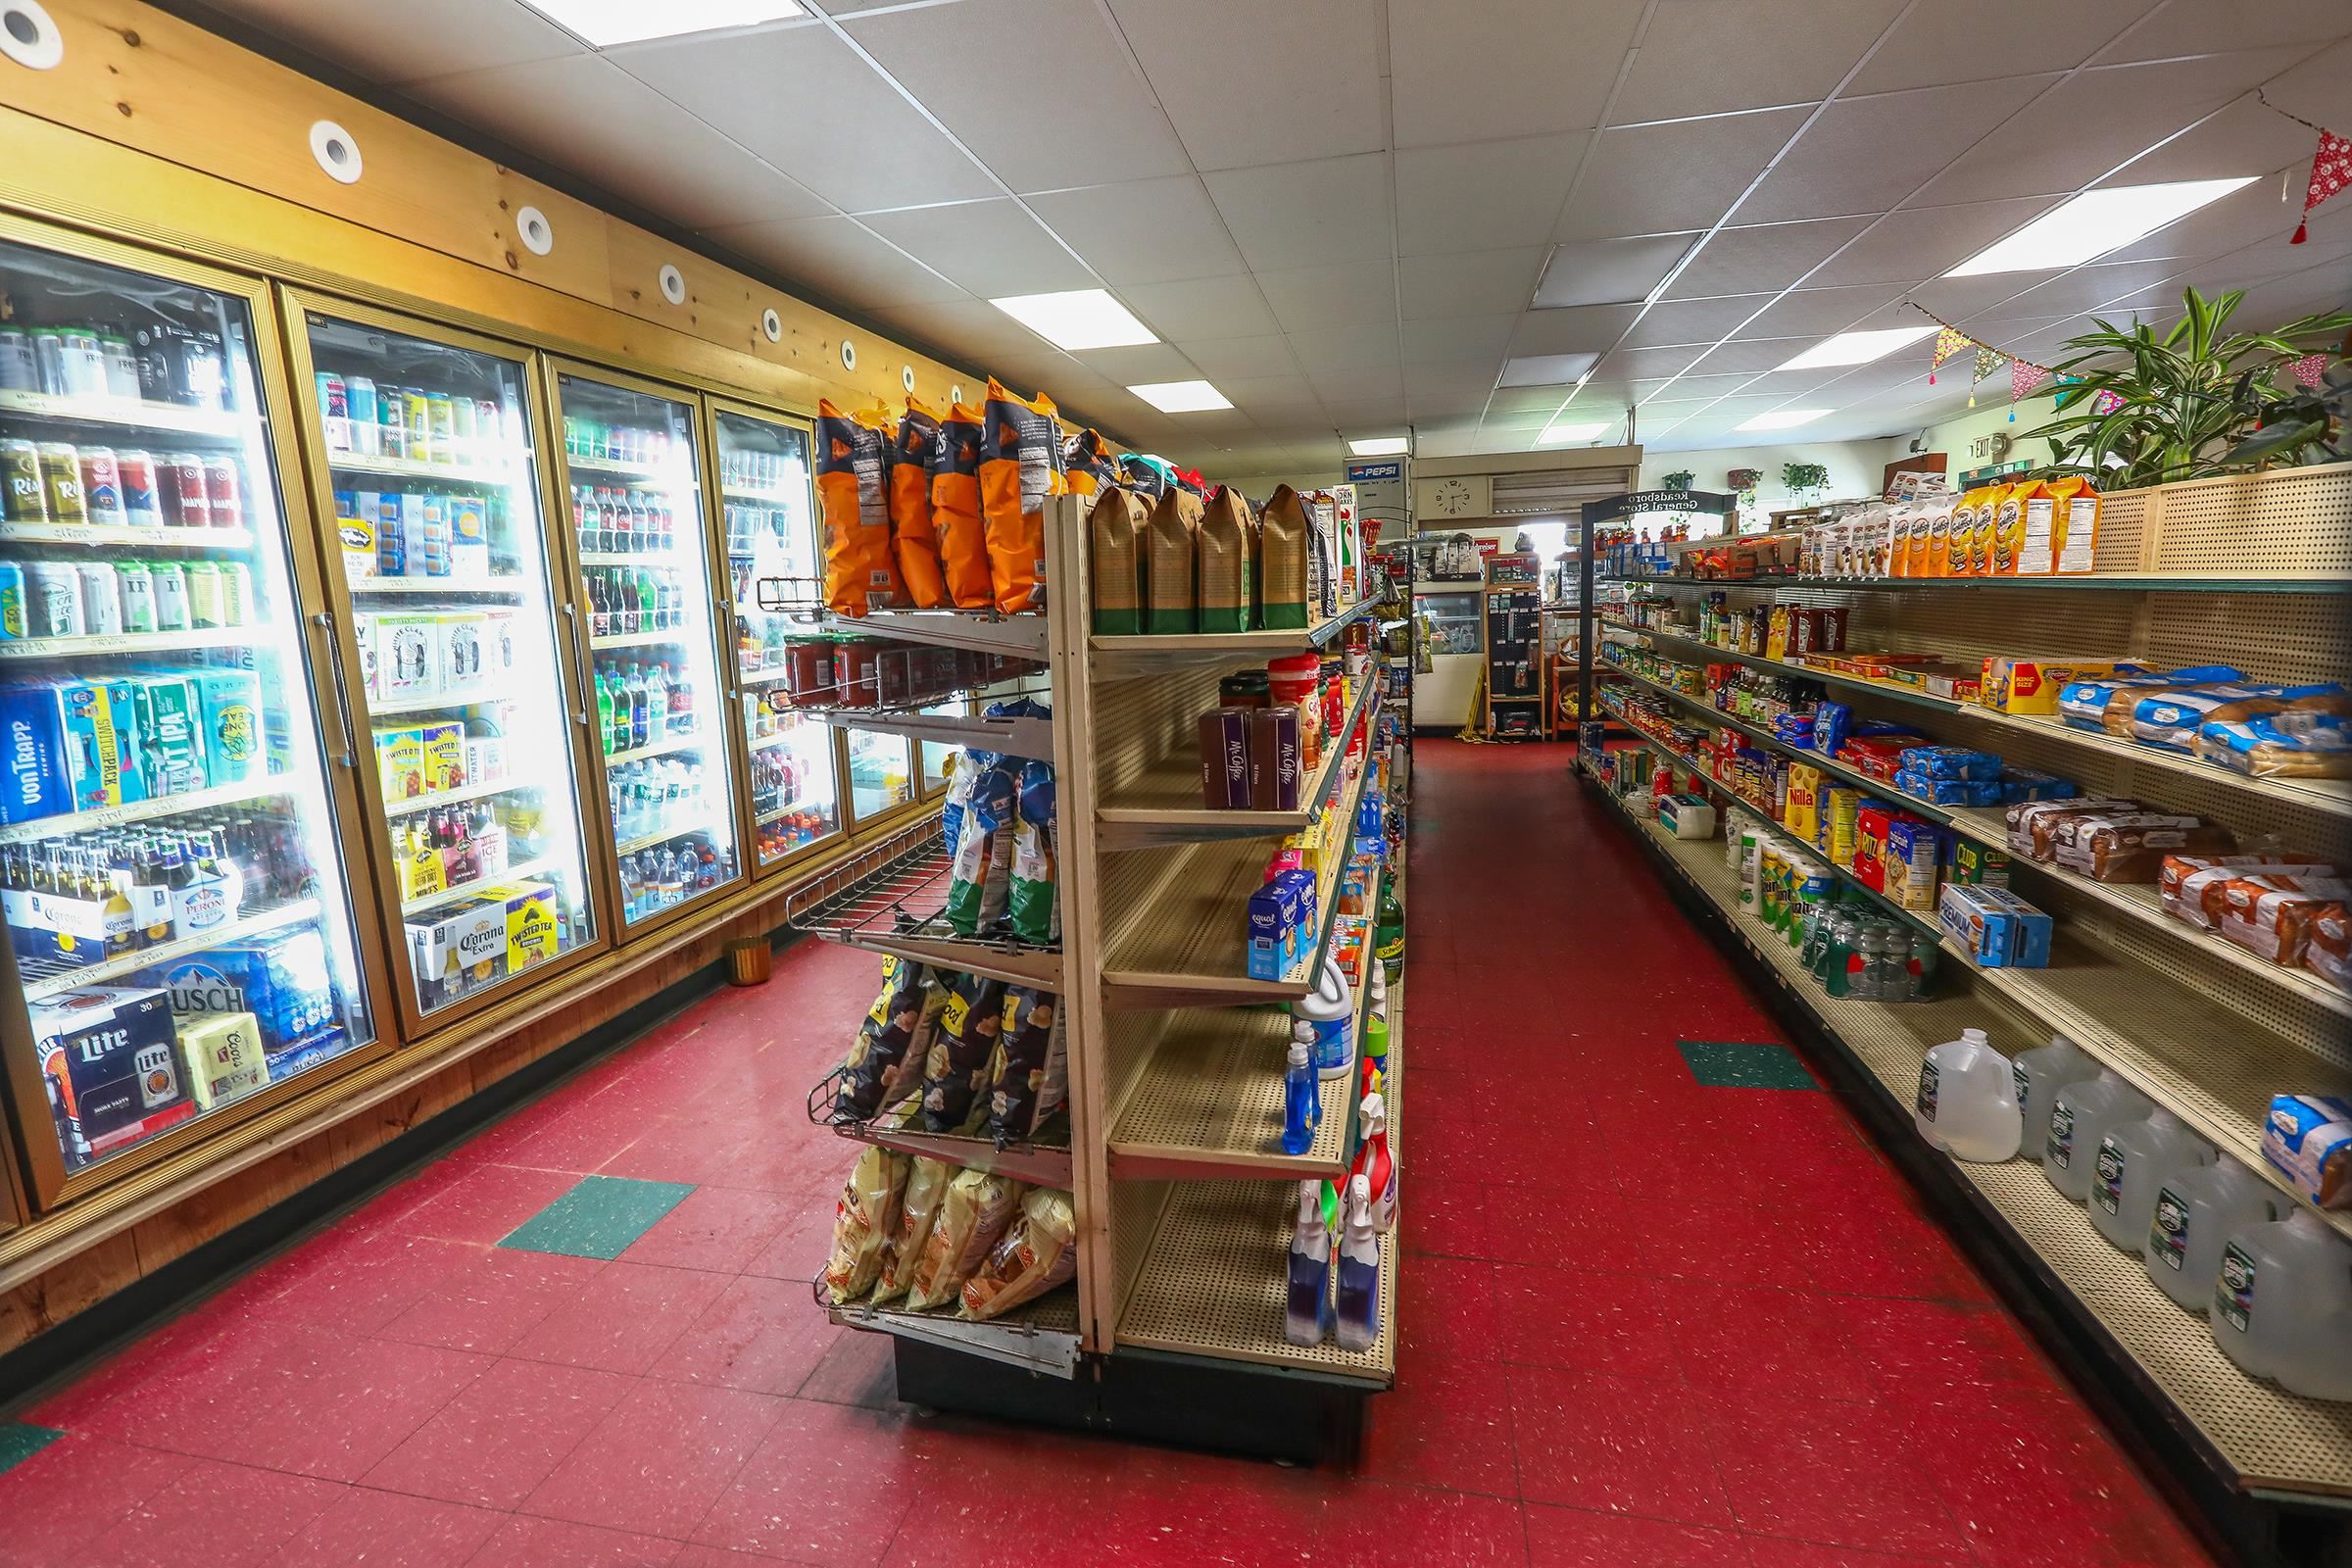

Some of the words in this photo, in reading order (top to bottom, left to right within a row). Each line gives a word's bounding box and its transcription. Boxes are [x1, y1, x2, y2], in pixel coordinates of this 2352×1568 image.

[1976, 438, 1990, 458] EXIT
[1364, 466, 1396, 477] PEPSI
[96, 718, 119, 787] SWITCHPACK
[1228, 740, 1242, 756] Mr.
[1281, 743, 1295, 759] Mr.
[1228, 755, 1245, 782] Coffee
[1279, 758, 1296, 785] Coffee
[1788, 788, 1813, 807] Nilla
[481, 845, 499, 858] ICE
[1862, 831, 1878, 856] RITZ
[1957, 843, 1978, 870] CLUB
[184, 899, 226, 915] PERONI
[105, 916, 134, 929] Corona
[1251, 912, 1277, 926] equal
[1940, 899, 1971, 936] PREMIUM
[460, 925, 505, 952] Corona
[510, 924, 540, 947] TWISTED
[540, 921, 554, 931] TEA
[470, 942, 495, 956] Extra
[140, 1001, 153, 1013] 30
[171, 988, 243, 1012] USCH
[79, 1028, 128, 1063] Lite
[225, 1031, 244, 1069] Coors
[269, 1056, 281, 1067] 30
